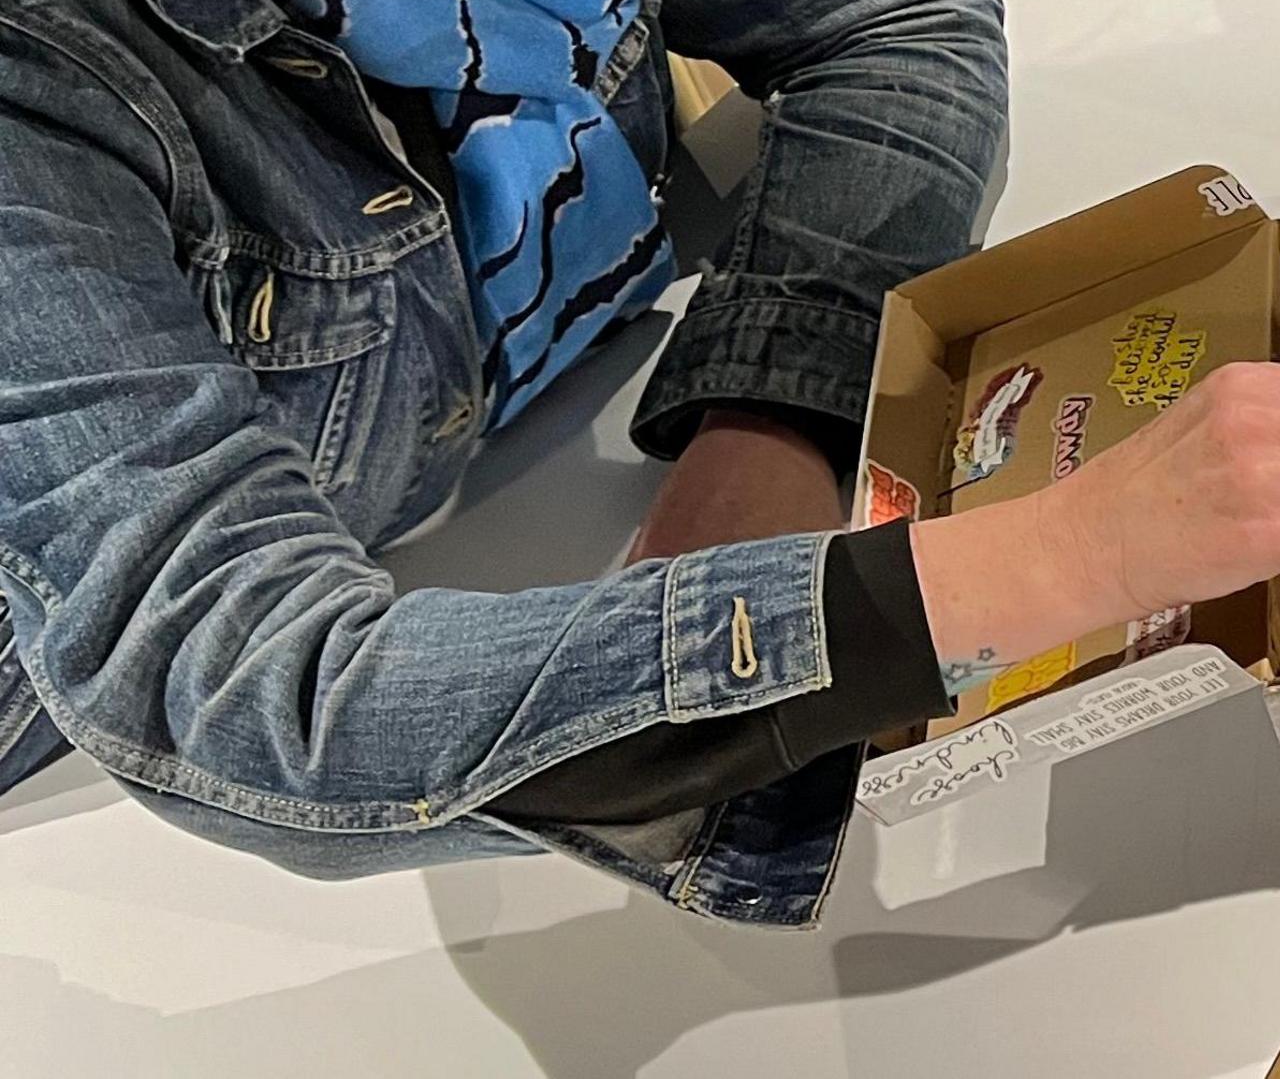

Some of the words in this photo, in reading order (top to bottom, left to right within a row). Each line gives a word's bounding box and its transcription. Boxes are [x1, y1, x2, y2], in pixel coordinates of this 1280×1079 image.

[1147, 313, 1176, 364] could
[1170, 338, 1200, 370] did
[1152, 364, 1171, 388] so
[1055, 397, 1093, 479] owdy
[1192, 660, 1222, 677] AND
[1157, 673, 1192, 692] YOUR
[1202, 678, 1225, 693] LET
[1102, 688, 1158, 713] WORRIES
[1164, 688, 1197, 707] YOUR
[1073, 709, 1103, 727] STAY
[1114, 701, 1164, 728] DREAMS
[1031, 721, 1073, 744] SMALL
[1087, 725, 1116, 741] STAY
[1060, 738, 1086, 751] BIG
[862, 721, 1013, 796] kindness
[917, 751, 1014, 802] choose
